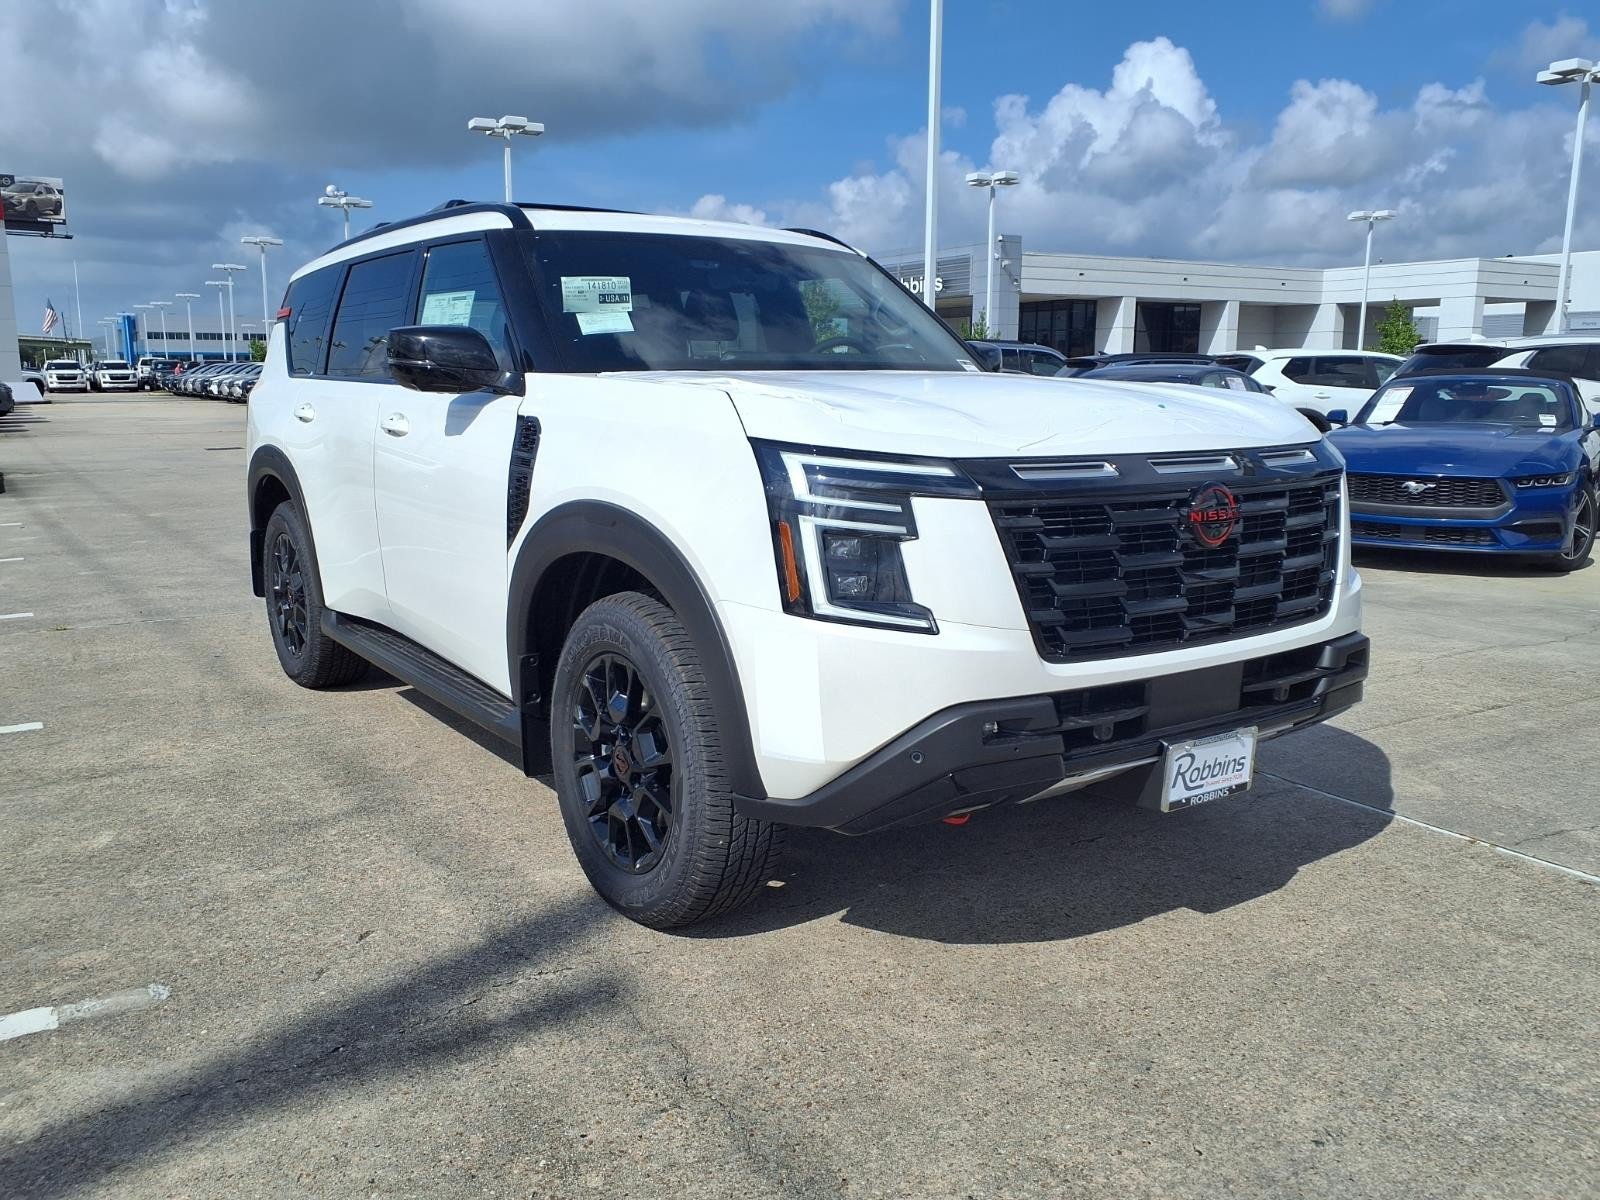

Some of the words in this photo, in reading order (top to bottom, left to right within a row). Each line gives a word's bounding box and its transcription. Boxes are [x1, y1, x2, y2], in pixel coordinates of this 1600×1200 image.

[587, 281, 617, 290] 141810
[605, 294, 620, 303] USA
[1172, 753, 1246, 791] Robbins
[1190, 788, 1229, 805] ROBBINS
